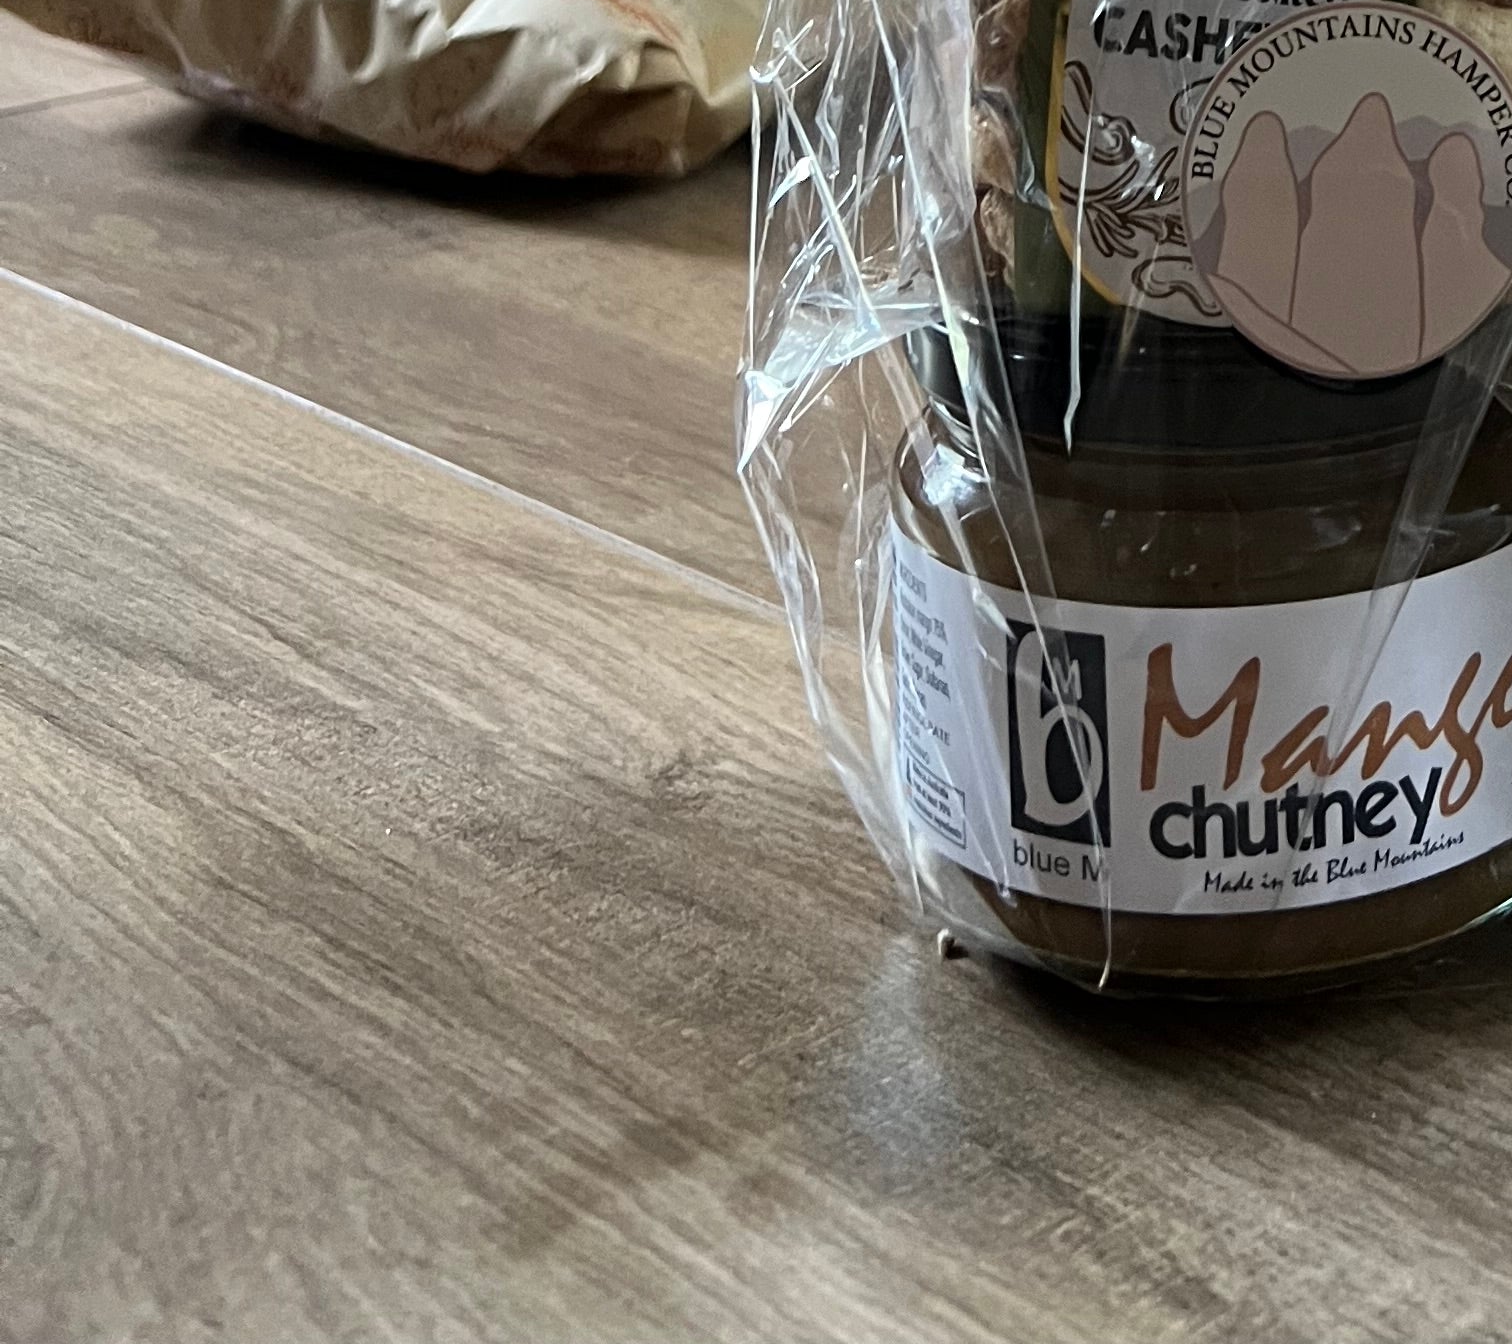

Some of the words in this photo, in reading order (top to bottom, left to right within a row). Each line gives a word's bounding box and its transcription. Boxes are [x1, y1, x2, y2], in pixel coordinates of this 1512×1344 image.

[1092, 7, 1271, 65] CASHE
[1192, 96, 1236, 180] BLUE
[1227, 14, 1417, 98] MOUNTAINS
[1149, 767, 1442, 860] chutney
[1013, 838, 1071, 878] blue
[1204, 870, 1255, 894] Made
[1260, 872, 1284, 892] in
[1291, 862, 1319, 888] the
[1325, 858, 1367, 885] Blue
[1373, 832, 1465, 873] Mountains
